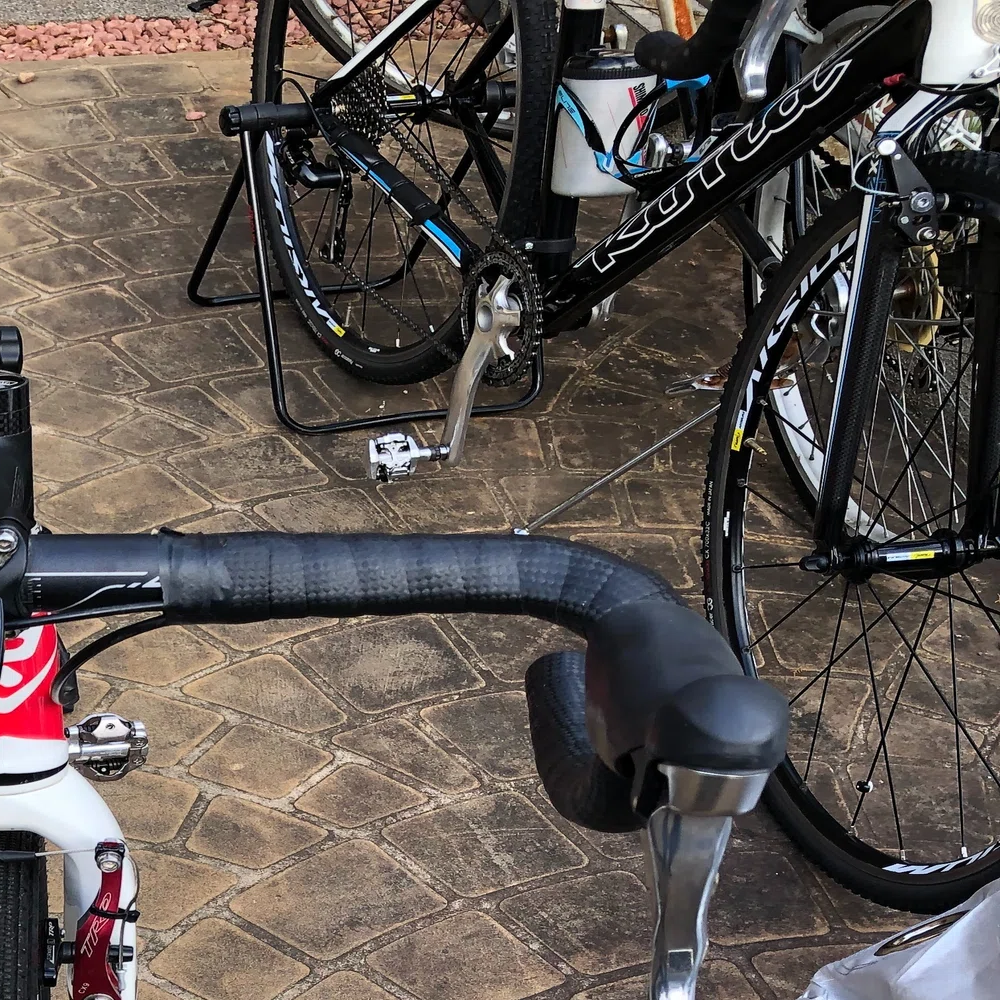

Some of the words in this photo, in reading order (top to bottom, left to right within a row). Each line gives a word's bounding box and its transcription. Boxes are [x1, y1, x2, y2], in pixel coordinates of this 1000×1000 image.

[633, 82, 649, 116] SHIO
[746, 229, 858, 412] AKSIU
[80, 892, 112, 958] TRP
[78, 982, 90, 995] CX9
